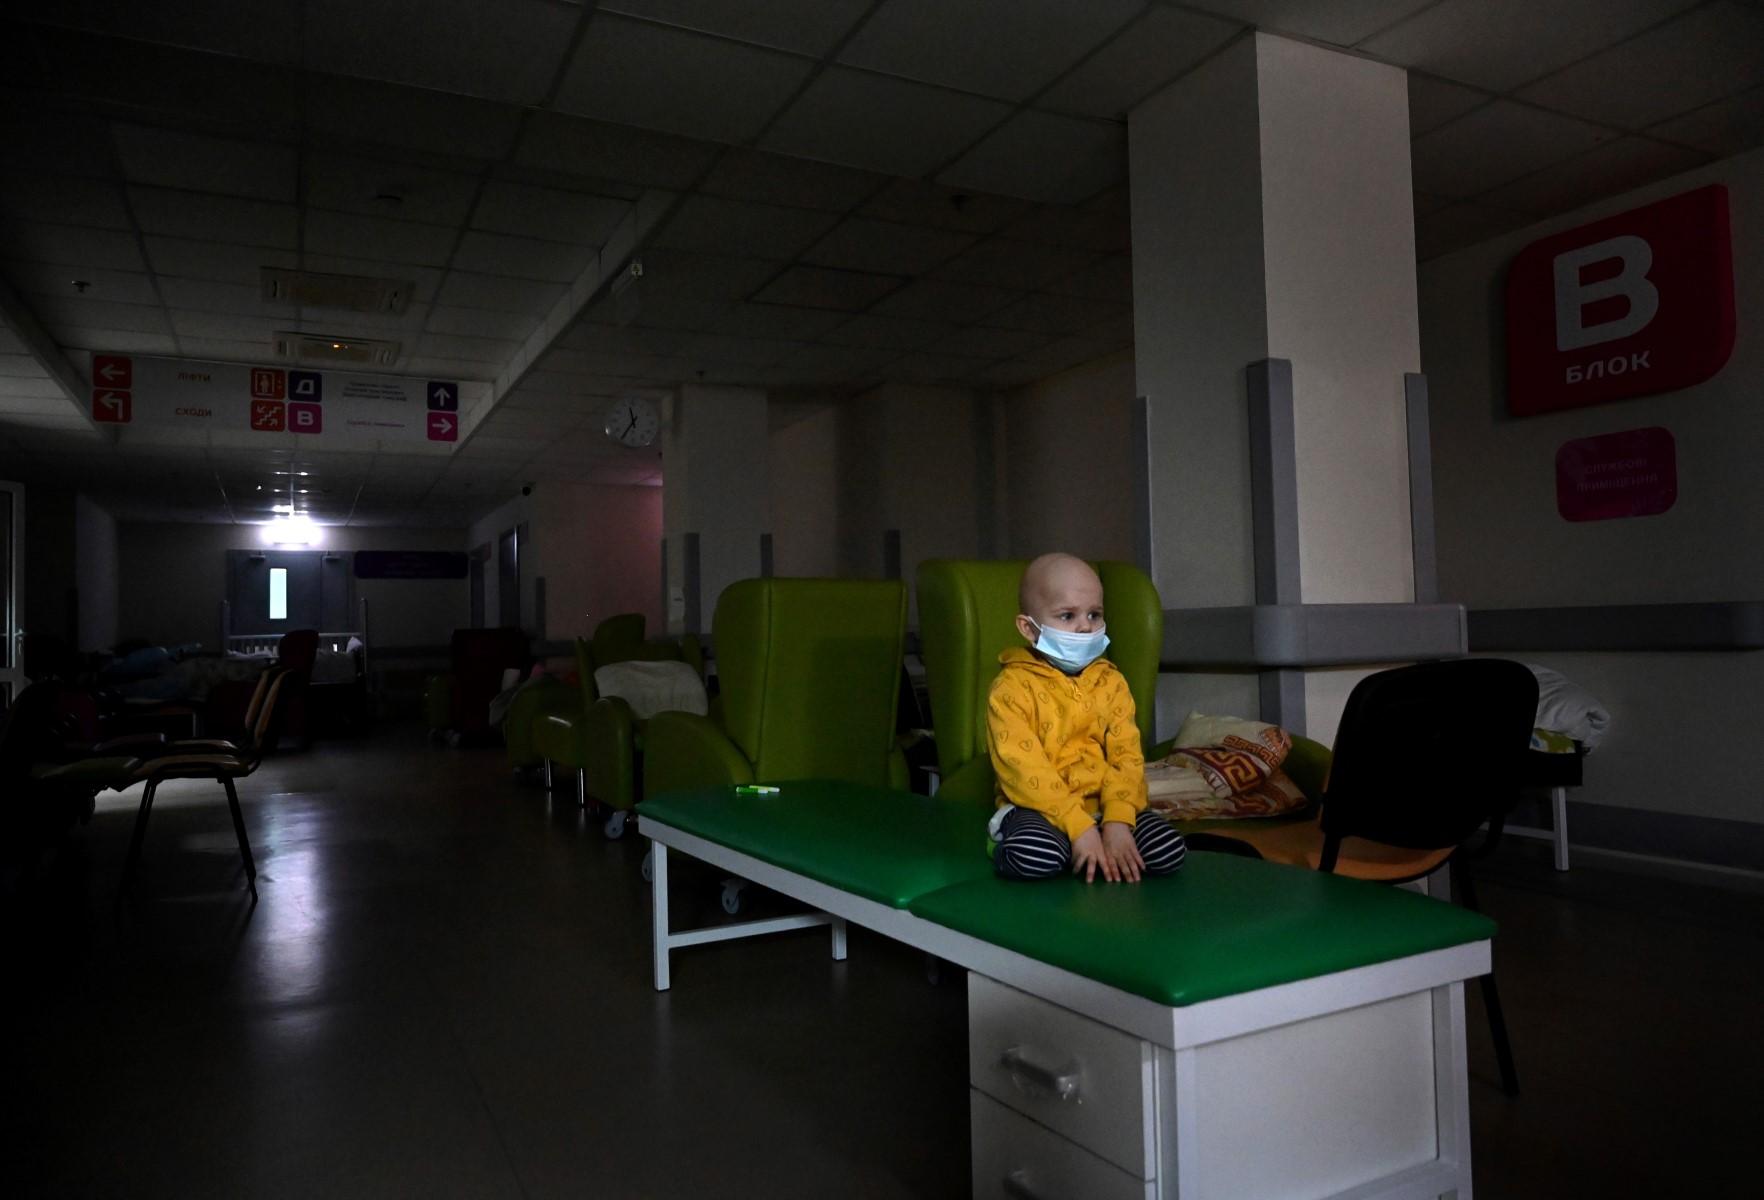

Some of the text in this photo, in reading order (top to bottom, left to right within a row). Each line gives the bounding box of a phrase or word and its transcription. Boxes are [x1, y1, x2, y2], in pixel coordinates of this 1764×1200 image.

[1553, 235, 1660, 352] В
[1566, 350, 1651, 384] БЛОК
[296, 379, 314, 395] Д
[175, 408, 211, 417] СХОДИ
[297, 410, 314, 426] В
